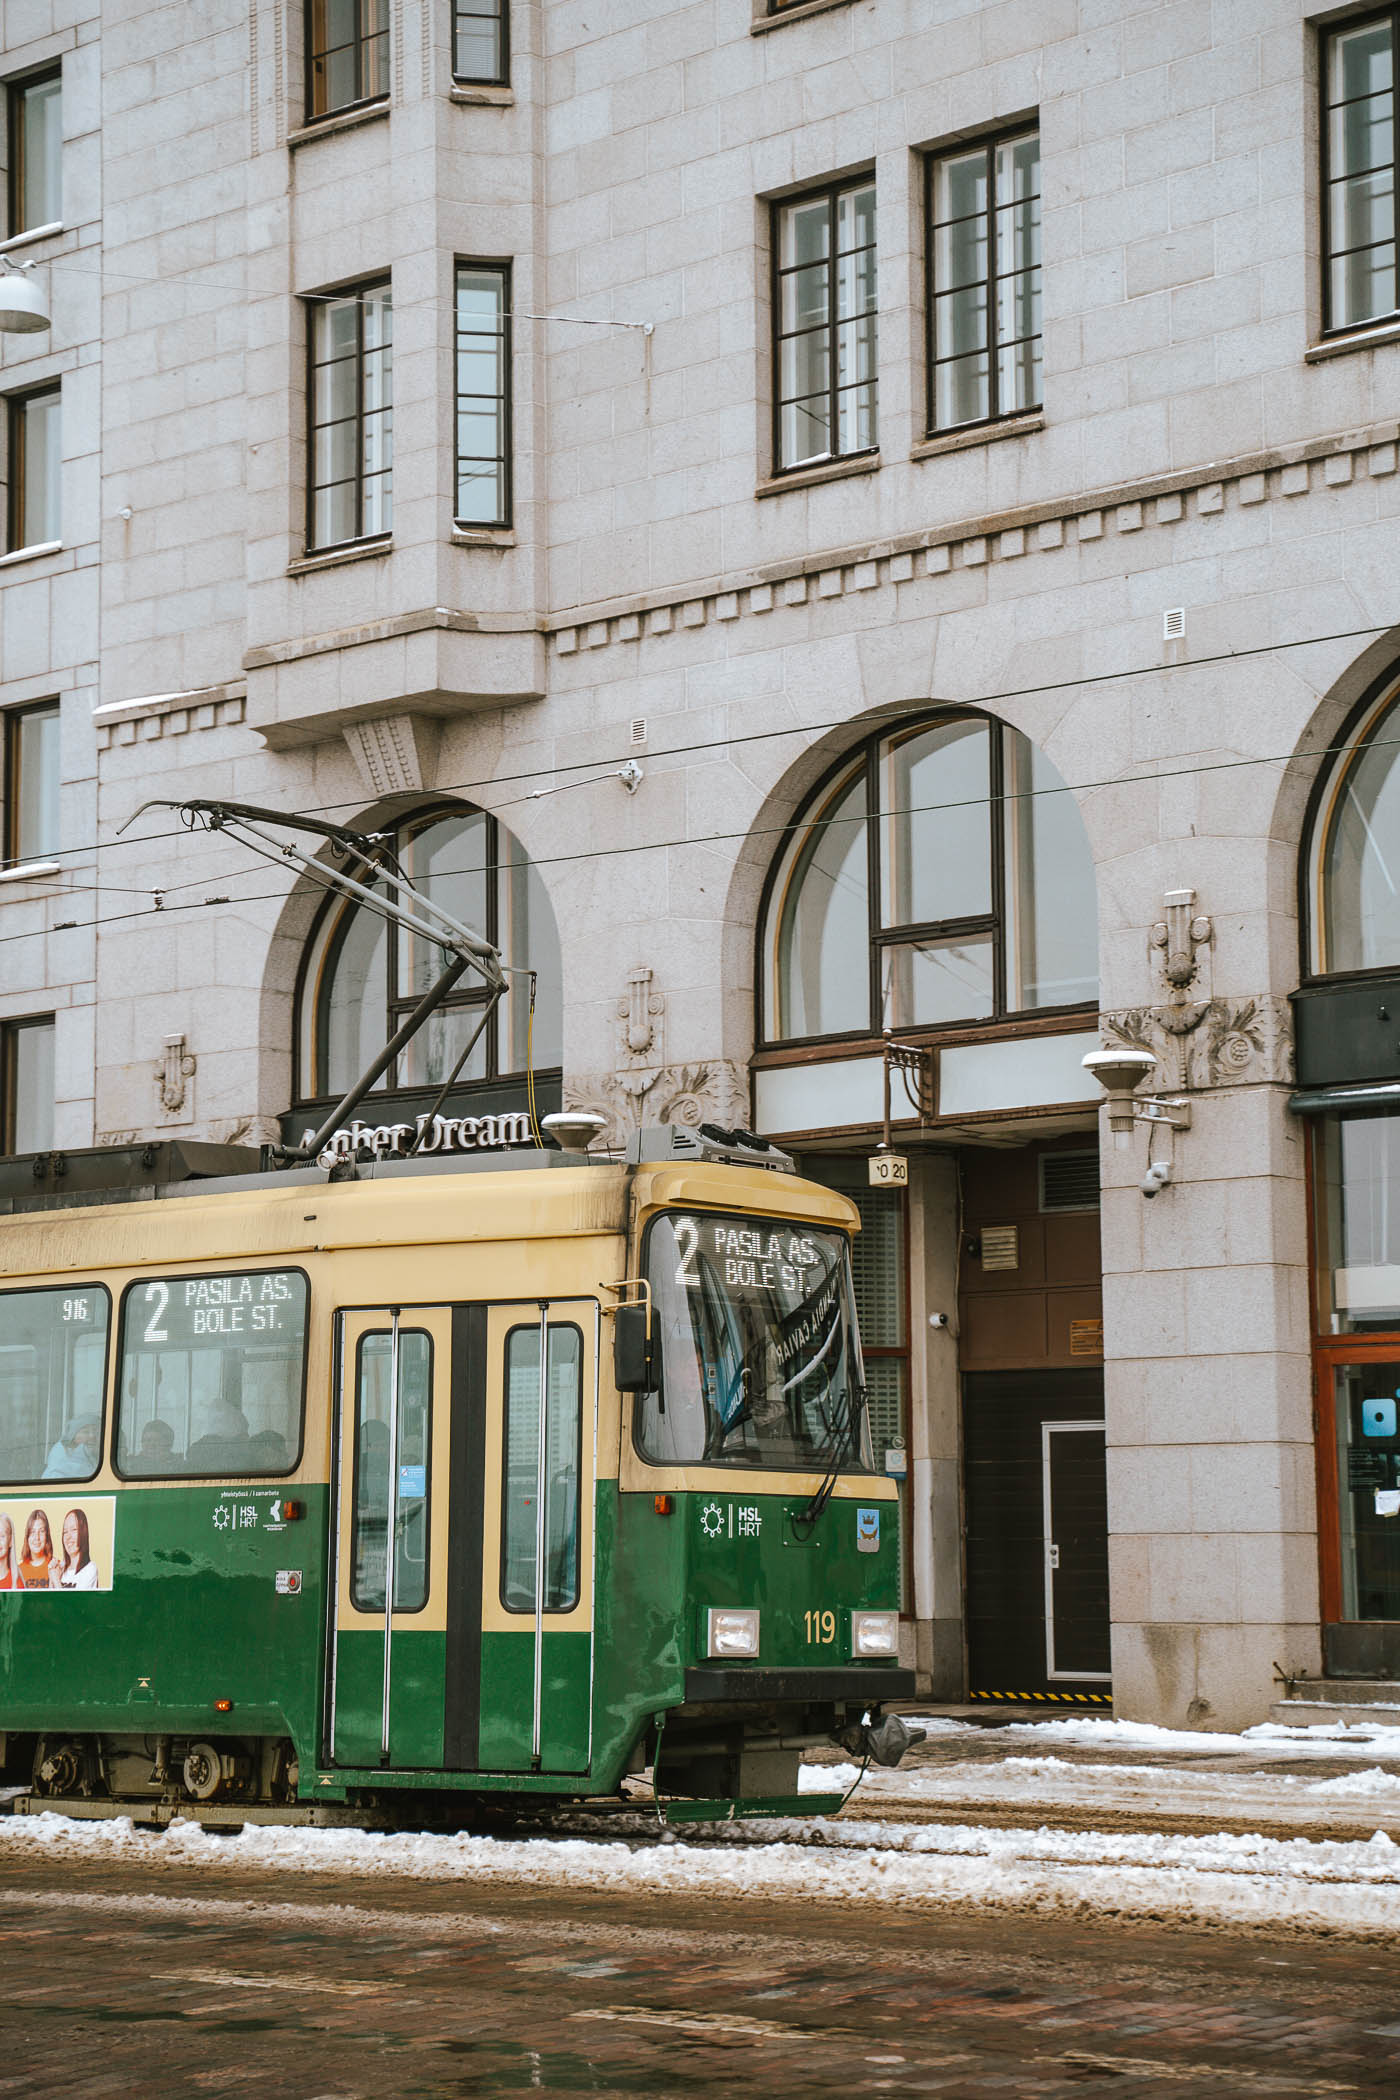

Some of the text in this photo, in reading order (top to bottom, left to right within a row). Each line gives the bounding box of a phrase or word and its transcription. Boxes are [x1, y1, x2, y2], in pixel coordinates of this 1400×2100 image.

[416, 1113, 536, 1151] Dream
[893, 1163, 905, 1179] 20
[673, 1218, 700, 1286] 2
[714, 1228, 819, 1264] PASILA AS.
[185, 1275, 293, 1306] PASILA AS.
[781, 1265, 812, 1292] ST.
[144, 1281, 169, 1342] 2
[251, 1304, 283, 1330] ST.
[239, 1505, 259, 1517] HSL
[239, 1517, 259, 1528] HRT
[738, 1507, 762, 1522] HSL
[738, 1522, 762, 1536] HRT
[804, 1610, 836, 1643] 119
